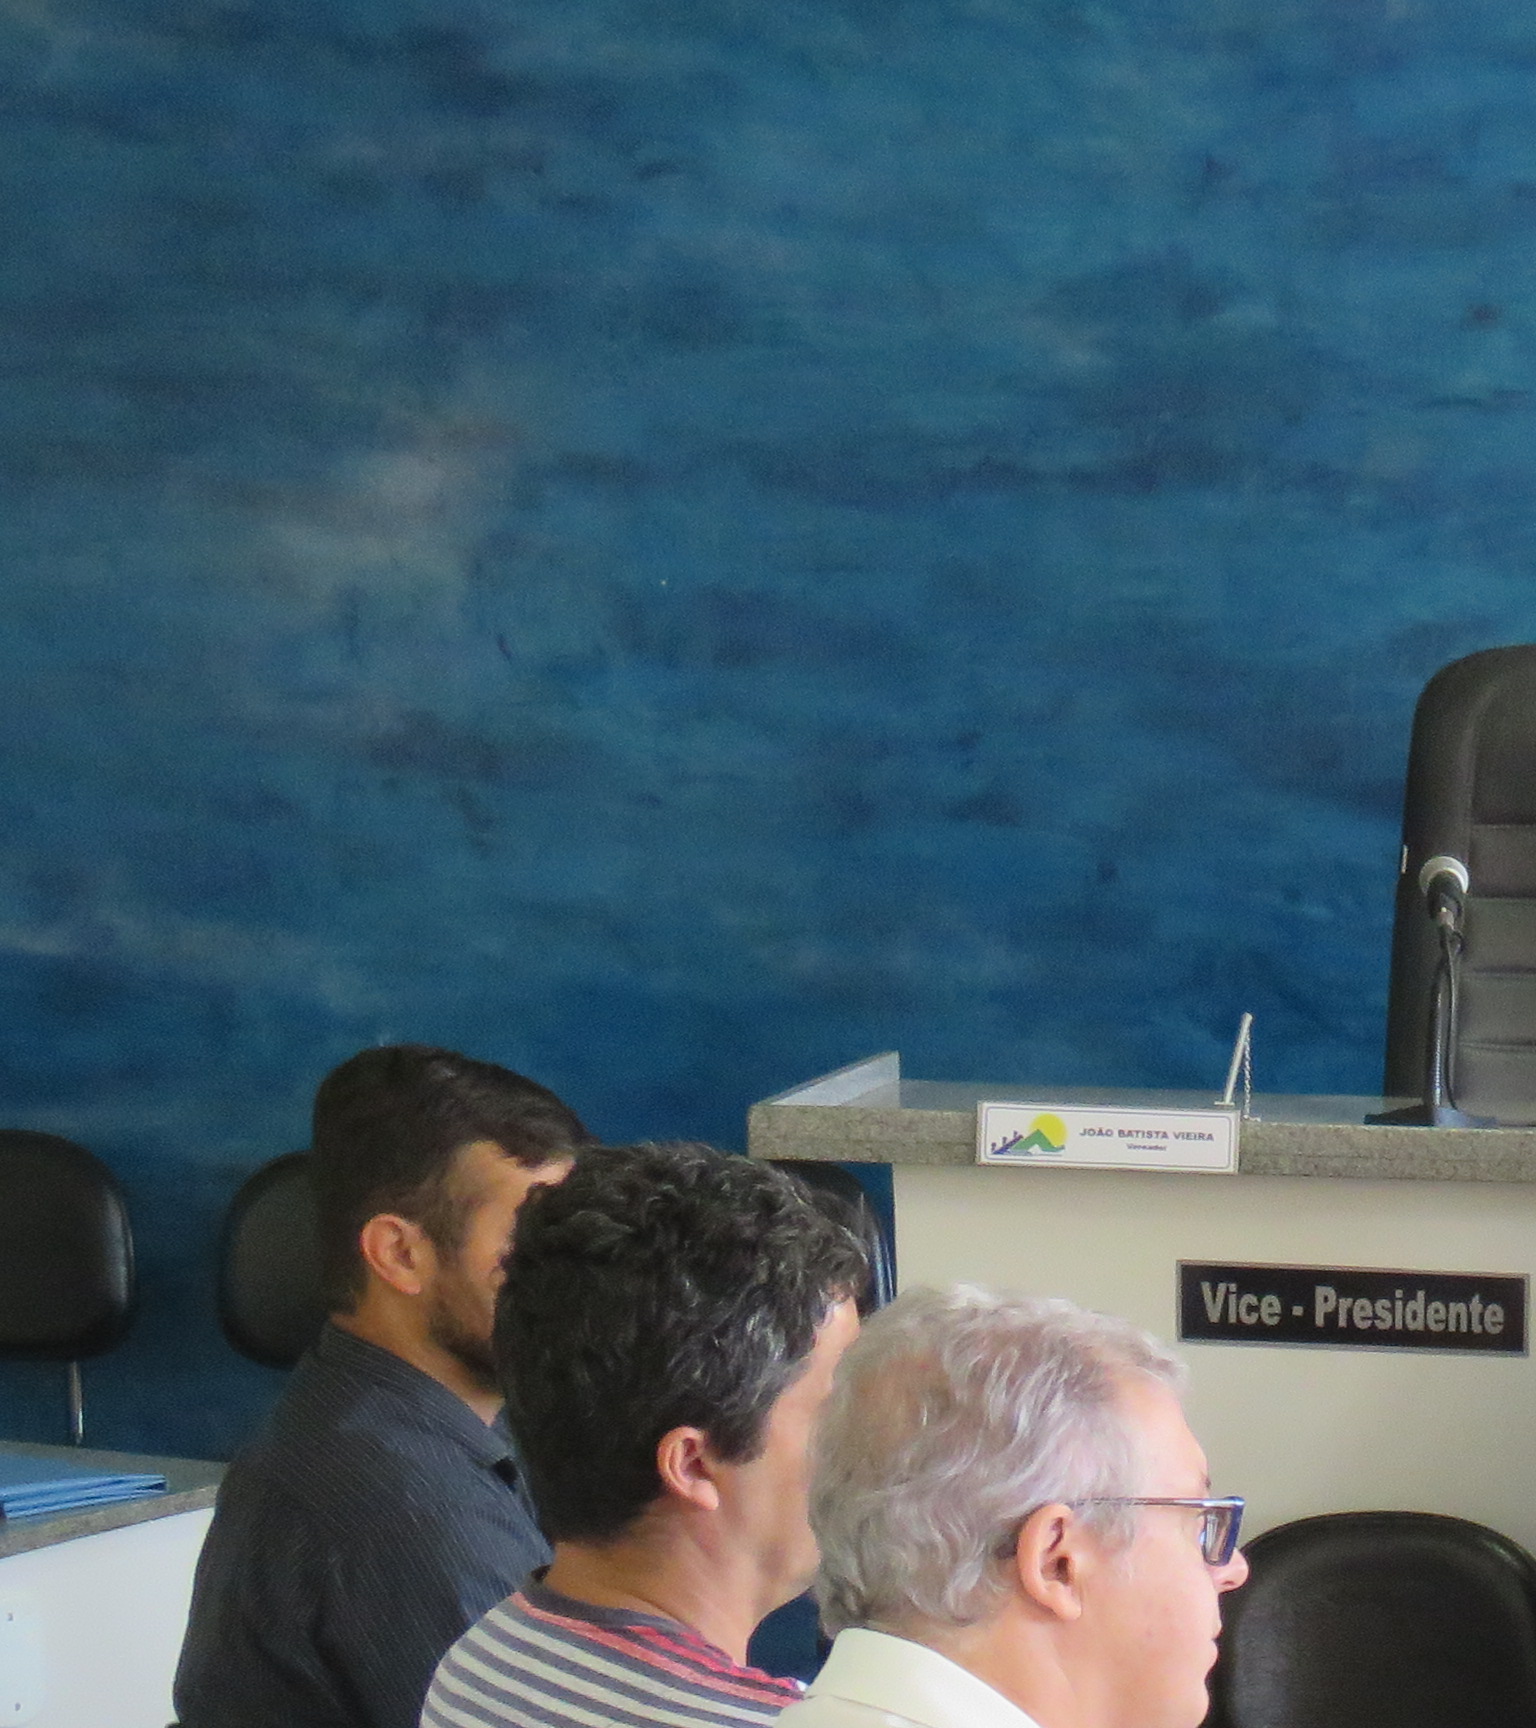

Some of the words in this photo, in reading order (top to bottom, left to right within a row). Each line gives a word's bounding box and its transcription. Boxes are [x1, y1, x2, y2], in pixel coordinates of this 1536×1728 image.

[1079, 1126, 1114, 1138] JOÃO
[1118, 1128, 1170, 1140] BATISTA
[1173, 1131, 1215, 1142] VIEIRA
[1201, 1281, 1282, 1327] Vice
[1313, 1285, 1505, 1335] Presidente
